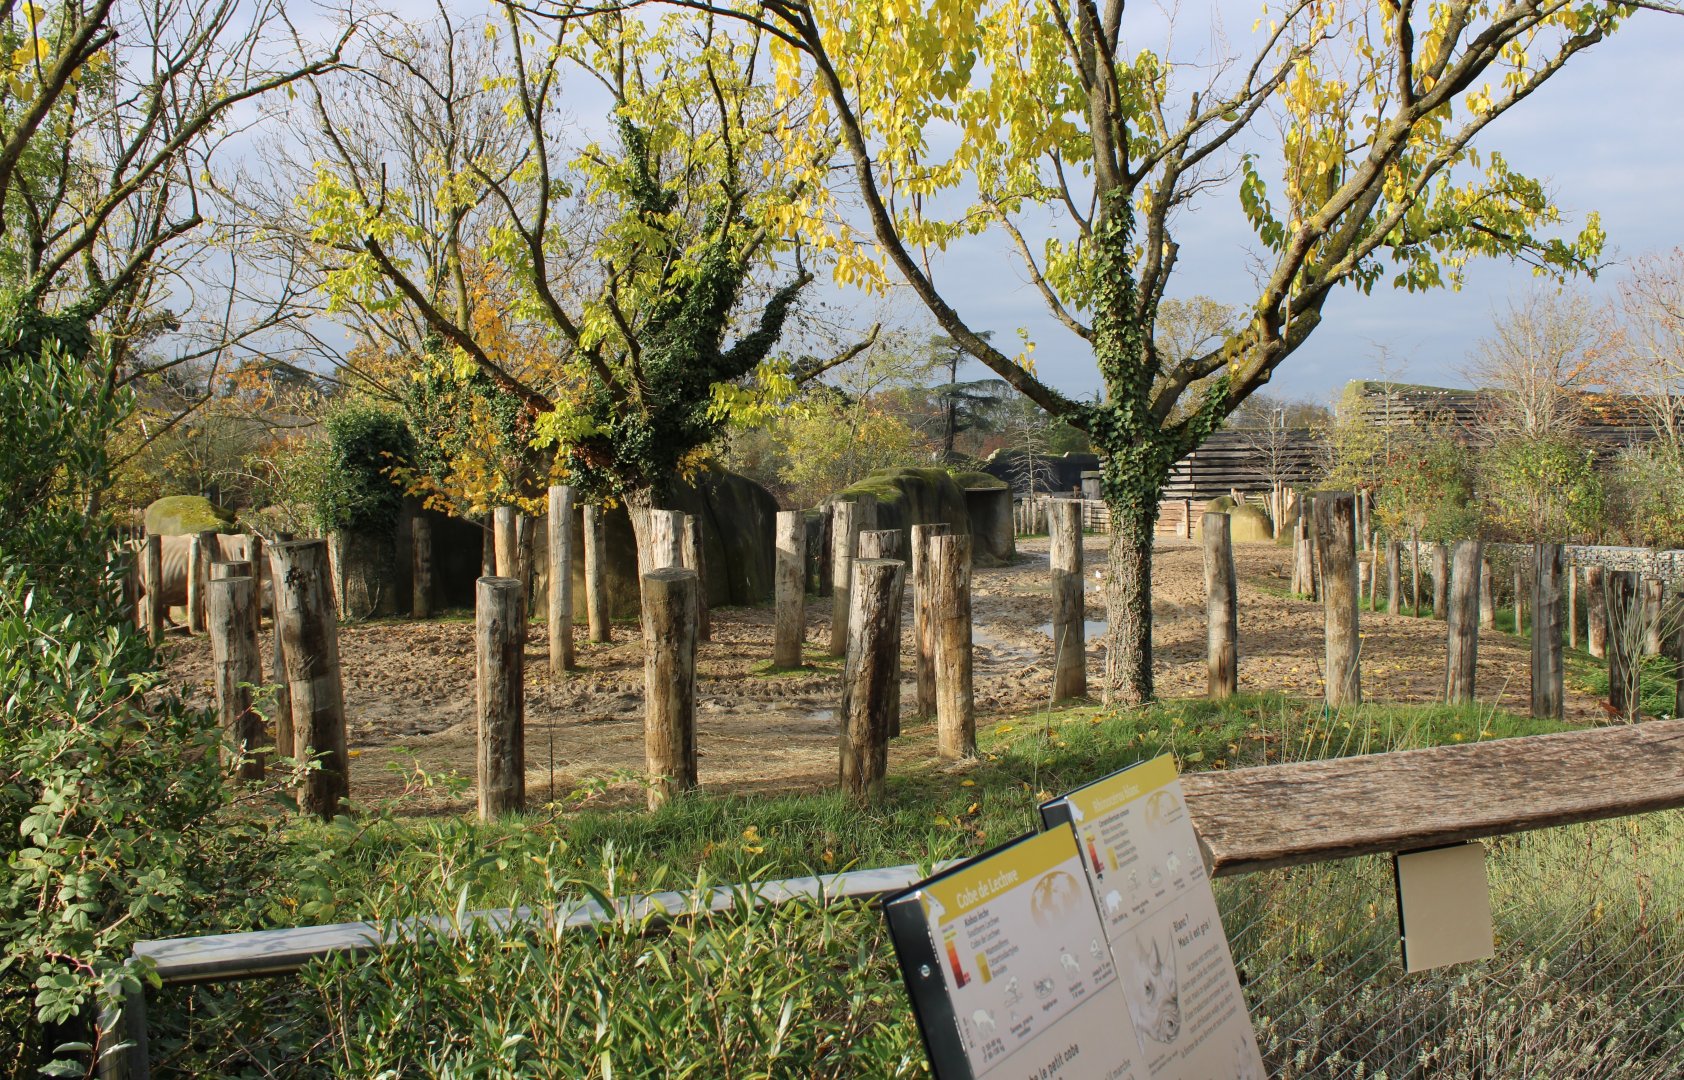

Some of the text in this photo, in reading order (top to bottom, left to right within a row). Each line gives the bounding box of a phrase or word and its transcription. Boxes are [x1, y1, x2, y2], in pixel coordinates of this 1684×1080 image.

[956, 870, 1019, 909] Cobe de Lechwe
[1172, 918, 1186, 932] Blanc
[1177, 935, 1190, 949] Mais
[1193, 925, 1201, 938] est
[1200, 920, 1209, 936] gris
[1038, 1043, 1080, 1080] le petit cobe
